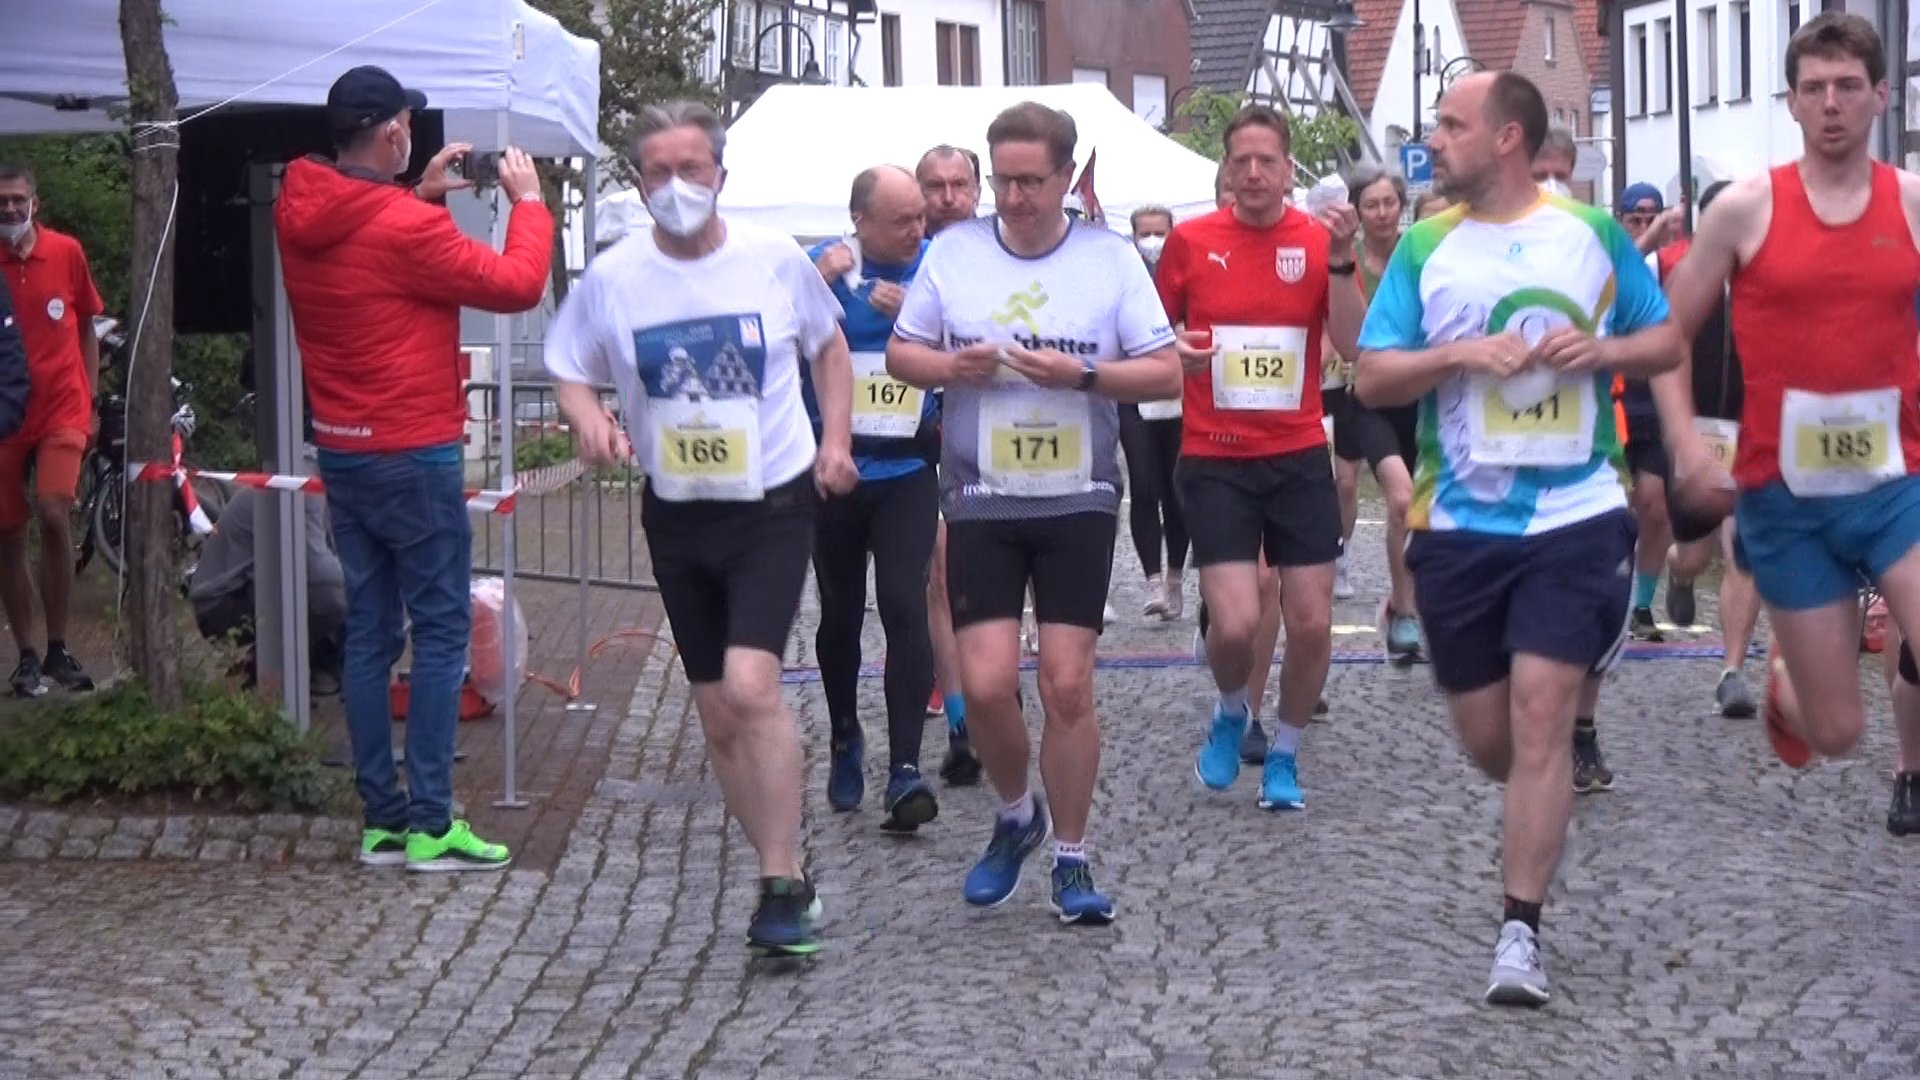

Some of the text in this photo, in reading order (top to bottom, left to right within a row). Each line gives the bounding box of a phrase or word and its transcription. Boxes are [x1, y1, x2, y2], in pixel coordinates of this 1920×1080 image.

[1407, 149, 1427, 178] P
[1240, 357, 1284, 378] 152
[867, 383, 908, 404] 167
[677, 438, 729, 464] 166
[1011, 435, 1058, 460] 171
[1818, 430, 1872, 457] 185
